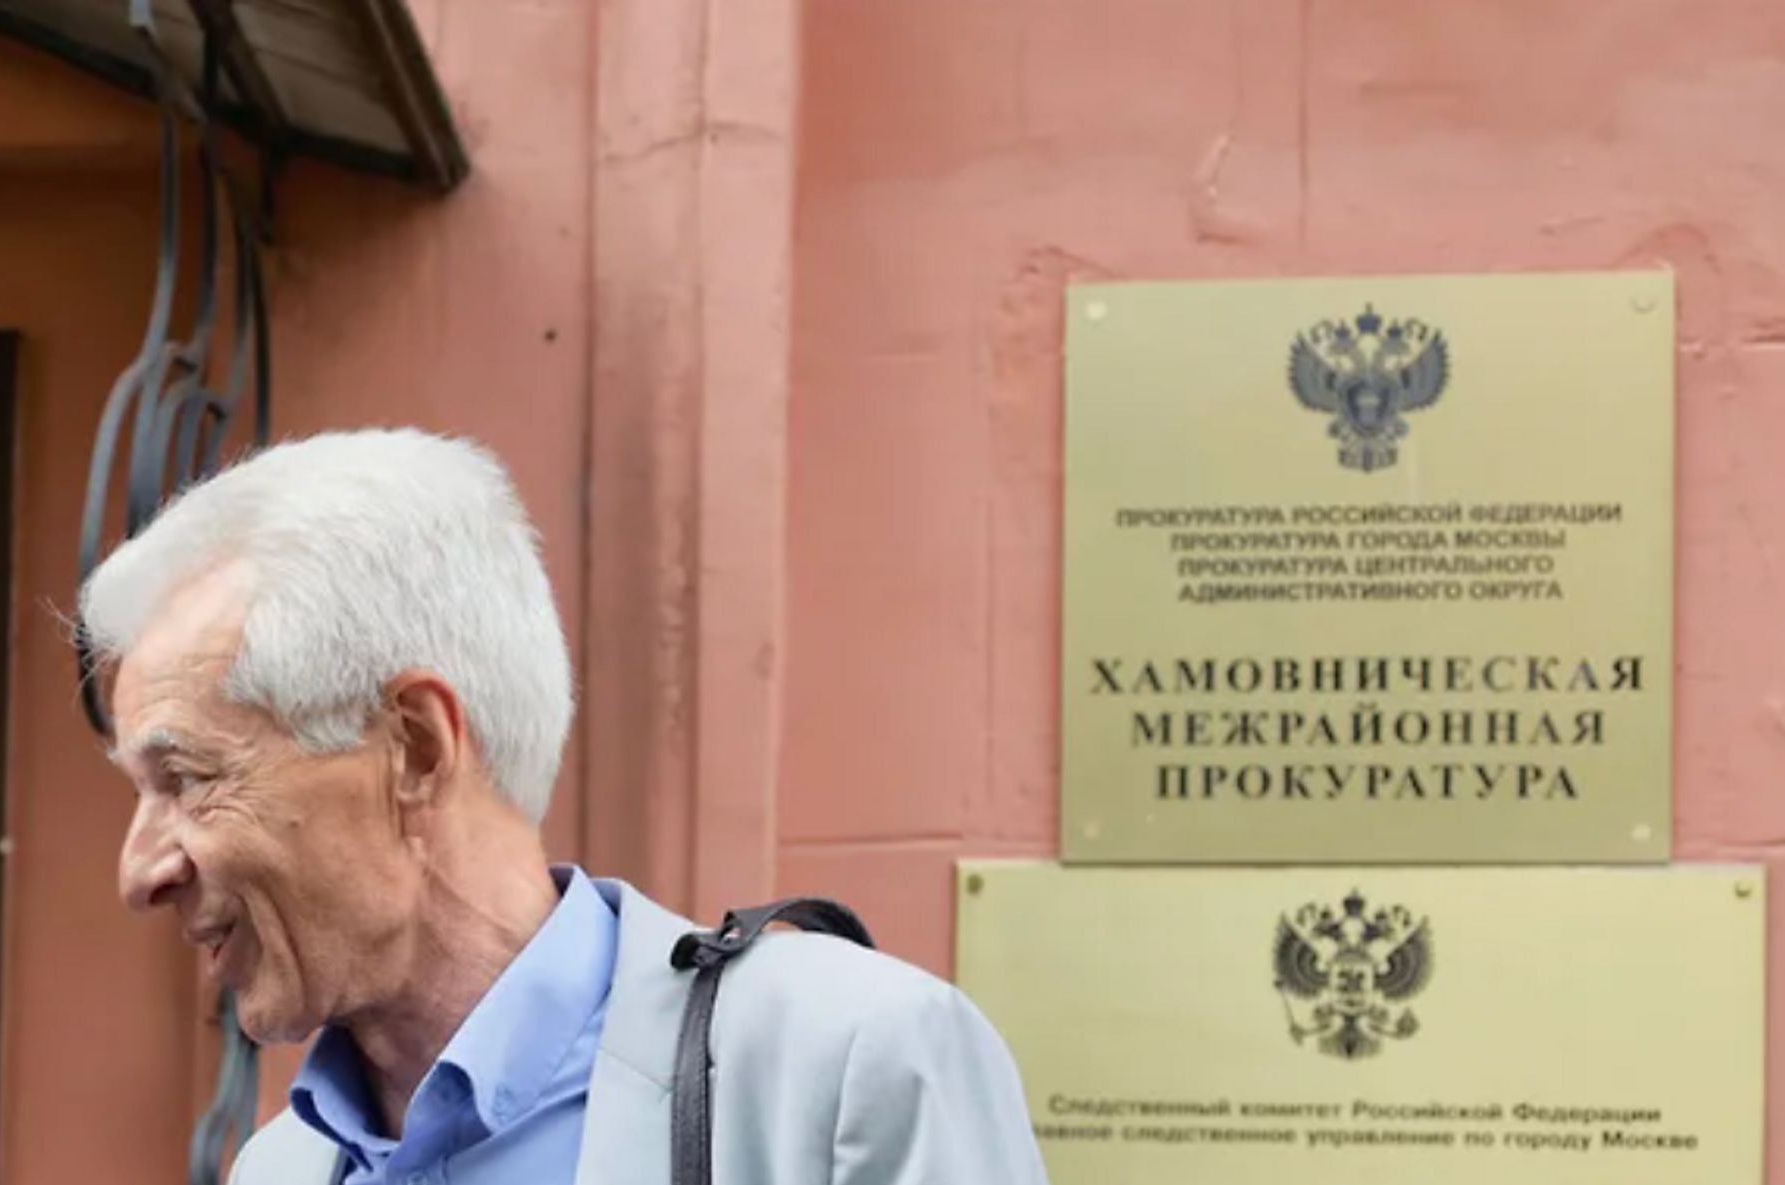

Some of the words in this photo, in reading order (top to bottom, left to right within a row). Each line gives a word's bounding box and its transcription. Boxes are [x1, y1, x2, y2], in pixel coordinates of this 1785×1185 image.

[1116, 506, 1286, 527] ПРОКУРАТУРА
[1292, 501, 1462, 525] РОССИЙСКОЙ
[1468, 502, 1623, 524] ФЕДЕРАЦИИ
[1170, 531, 1342, 551] ПРОКУРАТУРА
[1347, 530, 1448, 550] ГОРОДА
[1455, 529, 1567, 549] МОСКВЫ
[1177, 557, 1349, 577] ПРОКУРАТУРА
[1354, 554, 1555, 577] ЦЕНТРАЛЬНОГО
[1178, 581, 1463, 603] АДМИНИСТРАТИВНОГО
[1468, 580, 1564, 601] ОКРУГА
[1091, 656, 1644, 693] ХАМОВНИЧЕСКАЯ
[1131, 702, 1605, 747] МЕЖРАЙОННАЯ
[1155, 764, 1579, 800] ПРОКУРАТУРА
[1048, 1094, 1231, 1118] Следственный
[1240, 1103, 1342, 1118] комитет
[1351, 1101, 1503, 1121] Российской
[1512, 1102, 1662, 1124] Федерации
[1121, 1125, 1297, 1144] следственное
[1306, 1128, 1455, 1147] управление
[1465, 1131, 1495, 1147] по
[1503, 1131, 1592, 1151] городу
[1602, 1130, 1699, 1150] Москве
